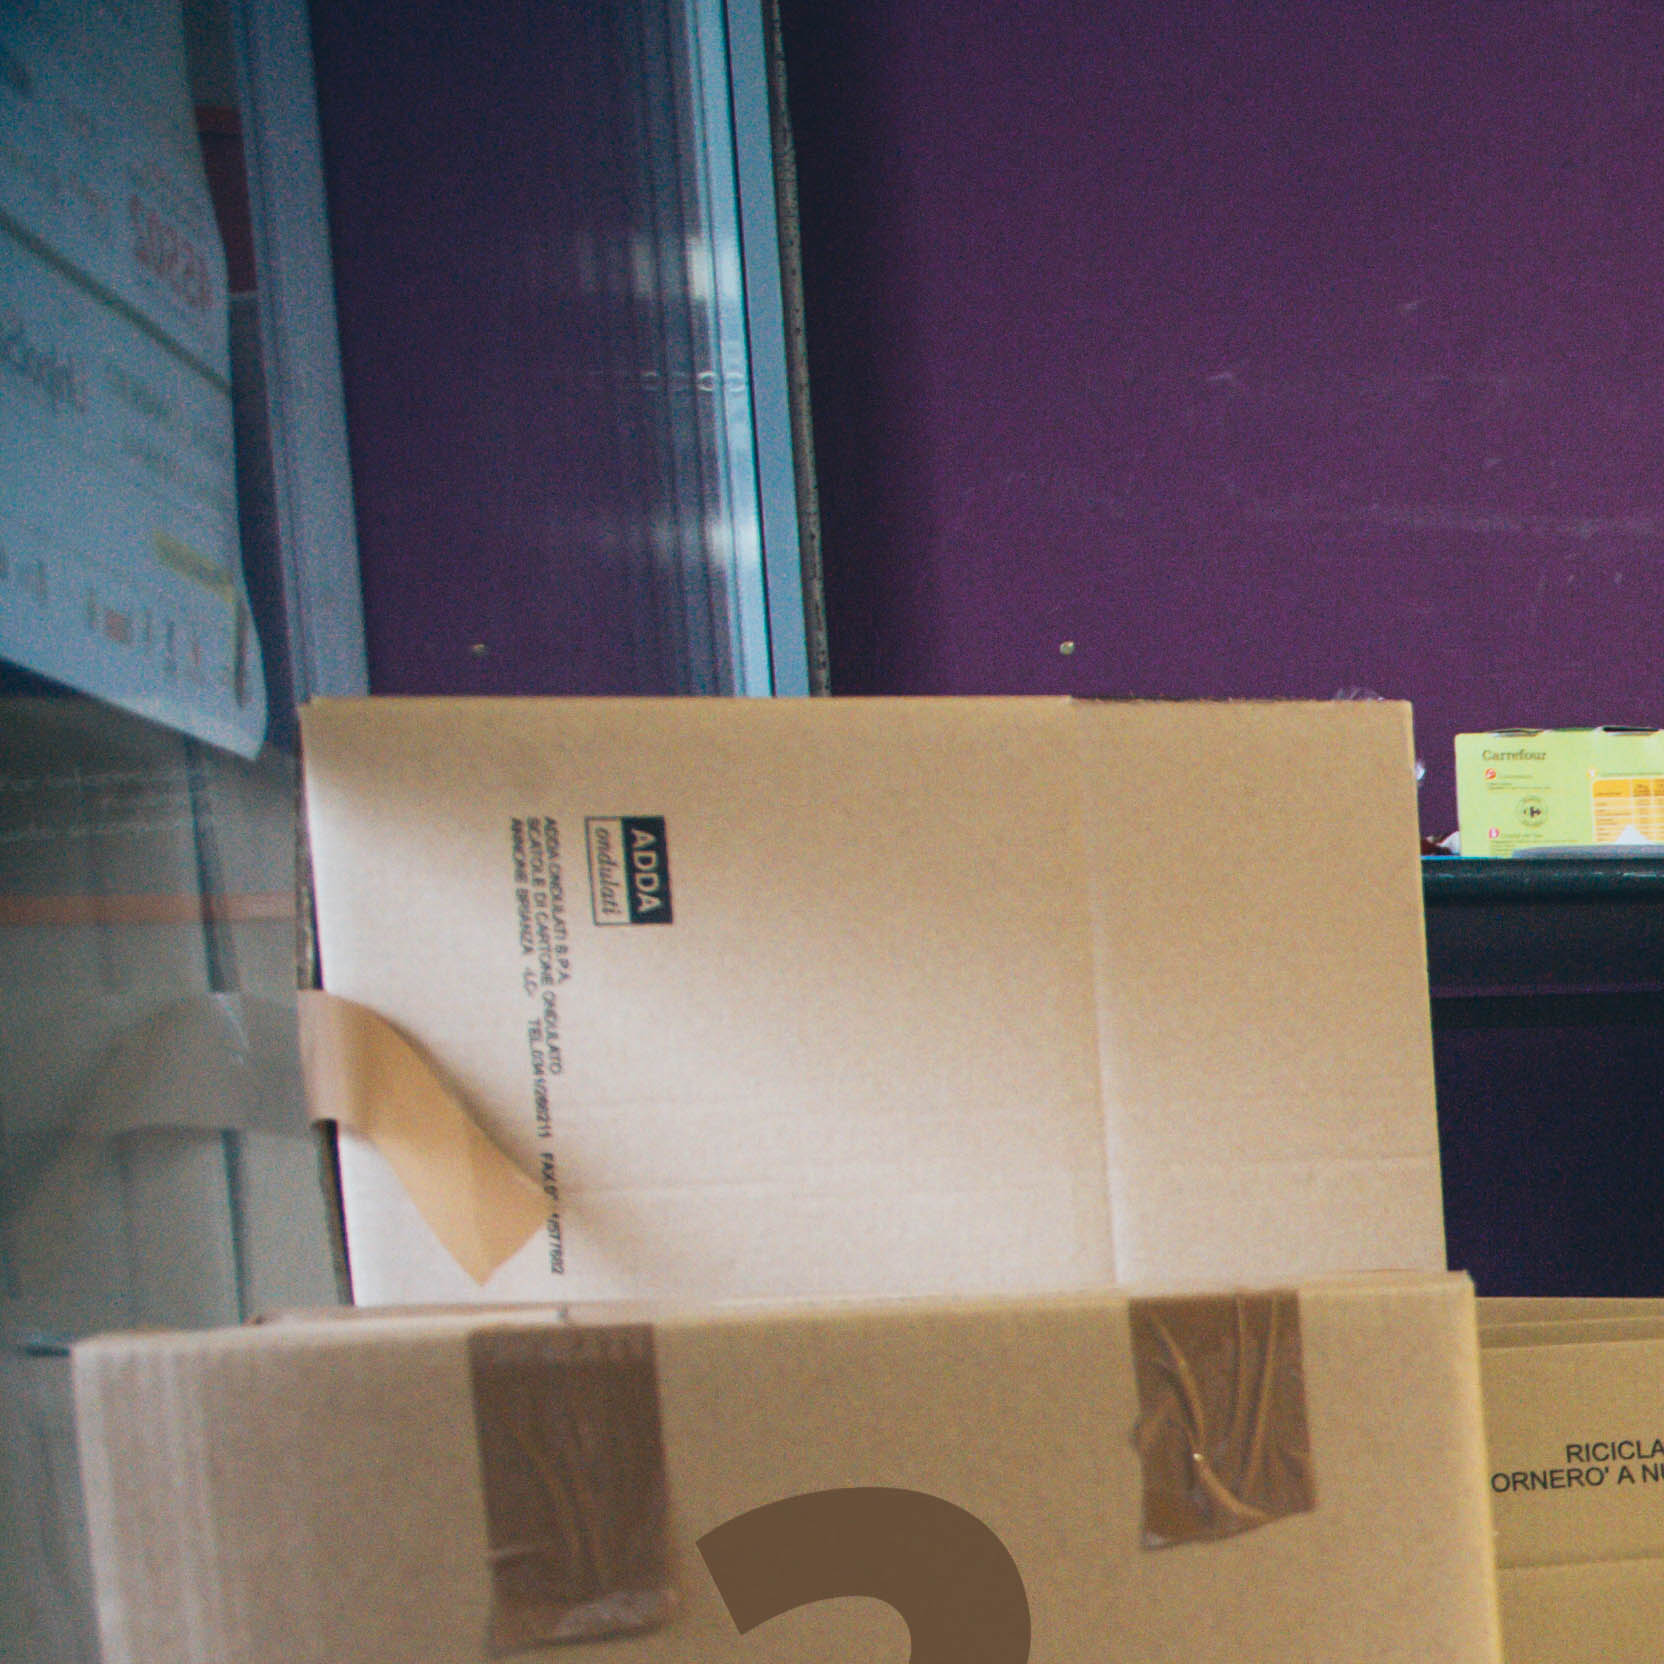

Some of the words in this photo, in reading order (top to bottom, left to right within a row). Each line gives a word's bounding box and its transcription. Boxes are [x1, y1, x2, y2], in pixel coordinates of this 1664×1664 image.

[1481, 748, 1547, 761] Carrefour
[526, 817, 547, 887] SCATOLE
[594, 827, 622, 915] ondulati
[630, 828, 665, 913] ADDA
[535, 910, 555, 986] CARTONE
[1490, 1465, 1610, 1493] ORNERO'
[1616, 1465, 1636, 1485] A
